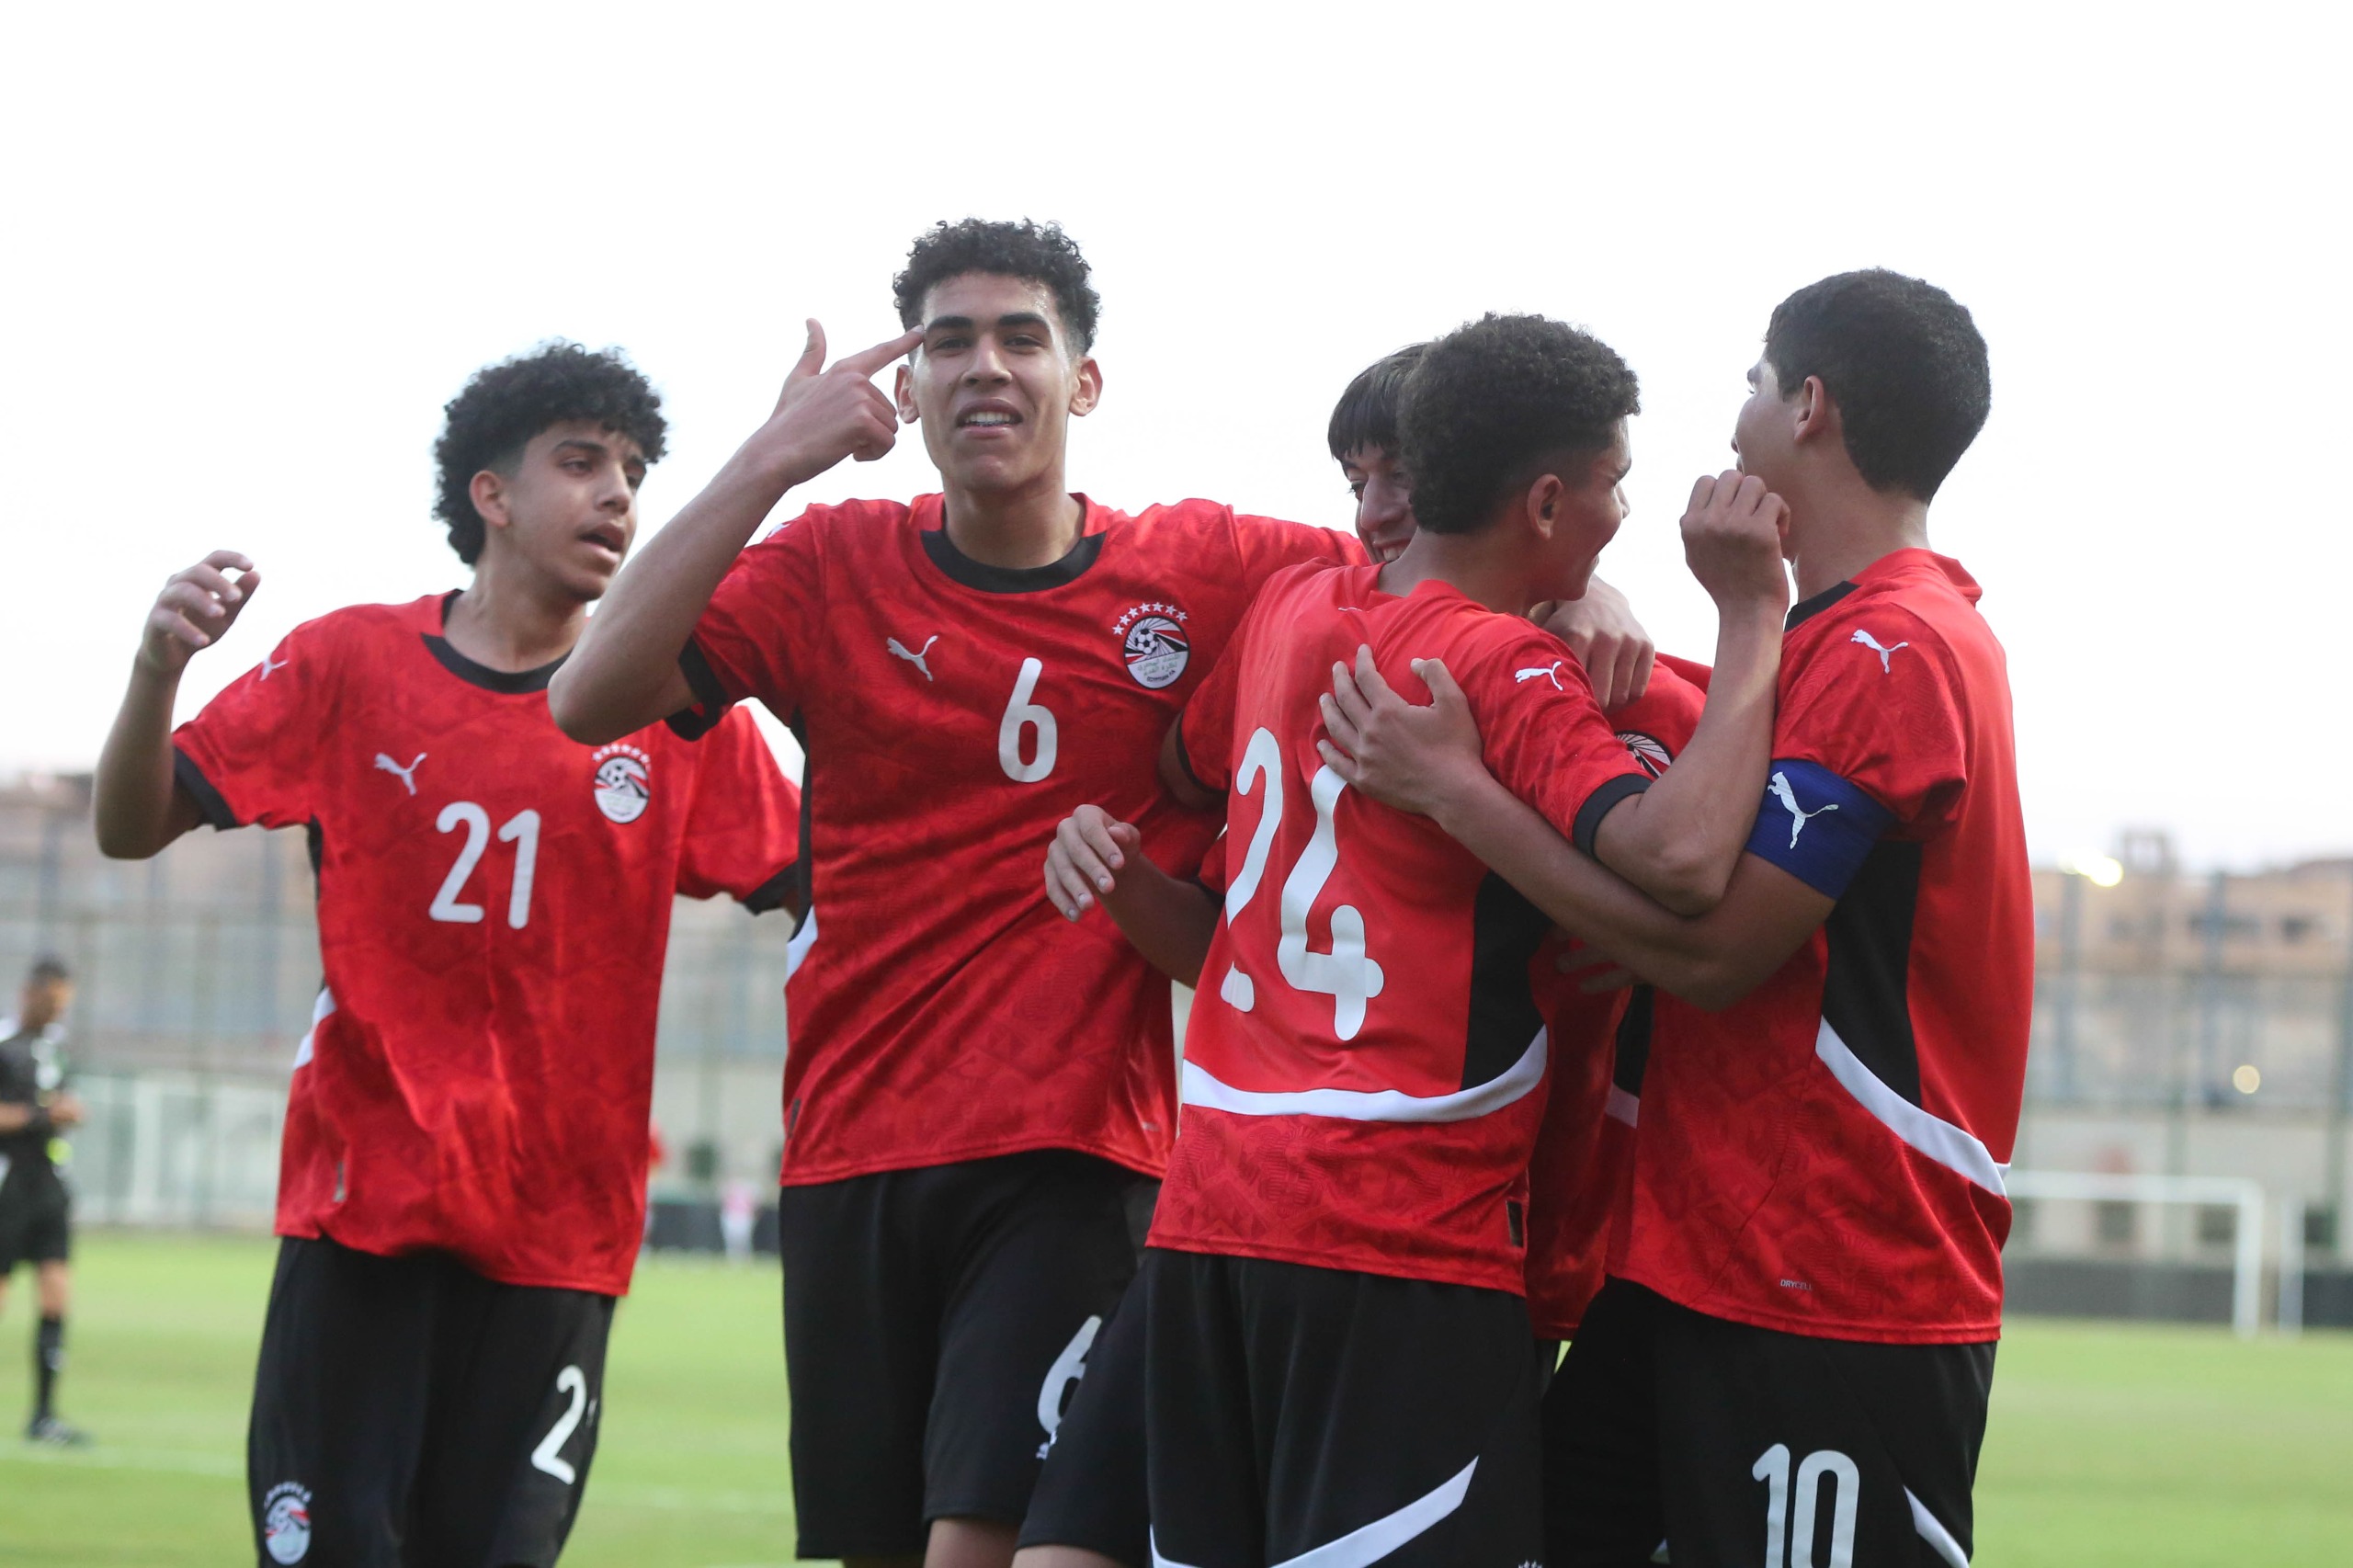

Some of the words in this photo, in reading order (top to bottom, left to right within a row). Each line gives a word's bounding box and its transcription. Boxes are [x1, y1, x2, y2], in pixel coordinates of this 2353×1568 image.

[998, 657, 1058, 783] 6
[429, 801, 540, 929] 21
[1220, 727, 1384, 1041] 24
[530, 1365, 597, 1485] 2
[1752, 1443, 1860, 1568] 10
